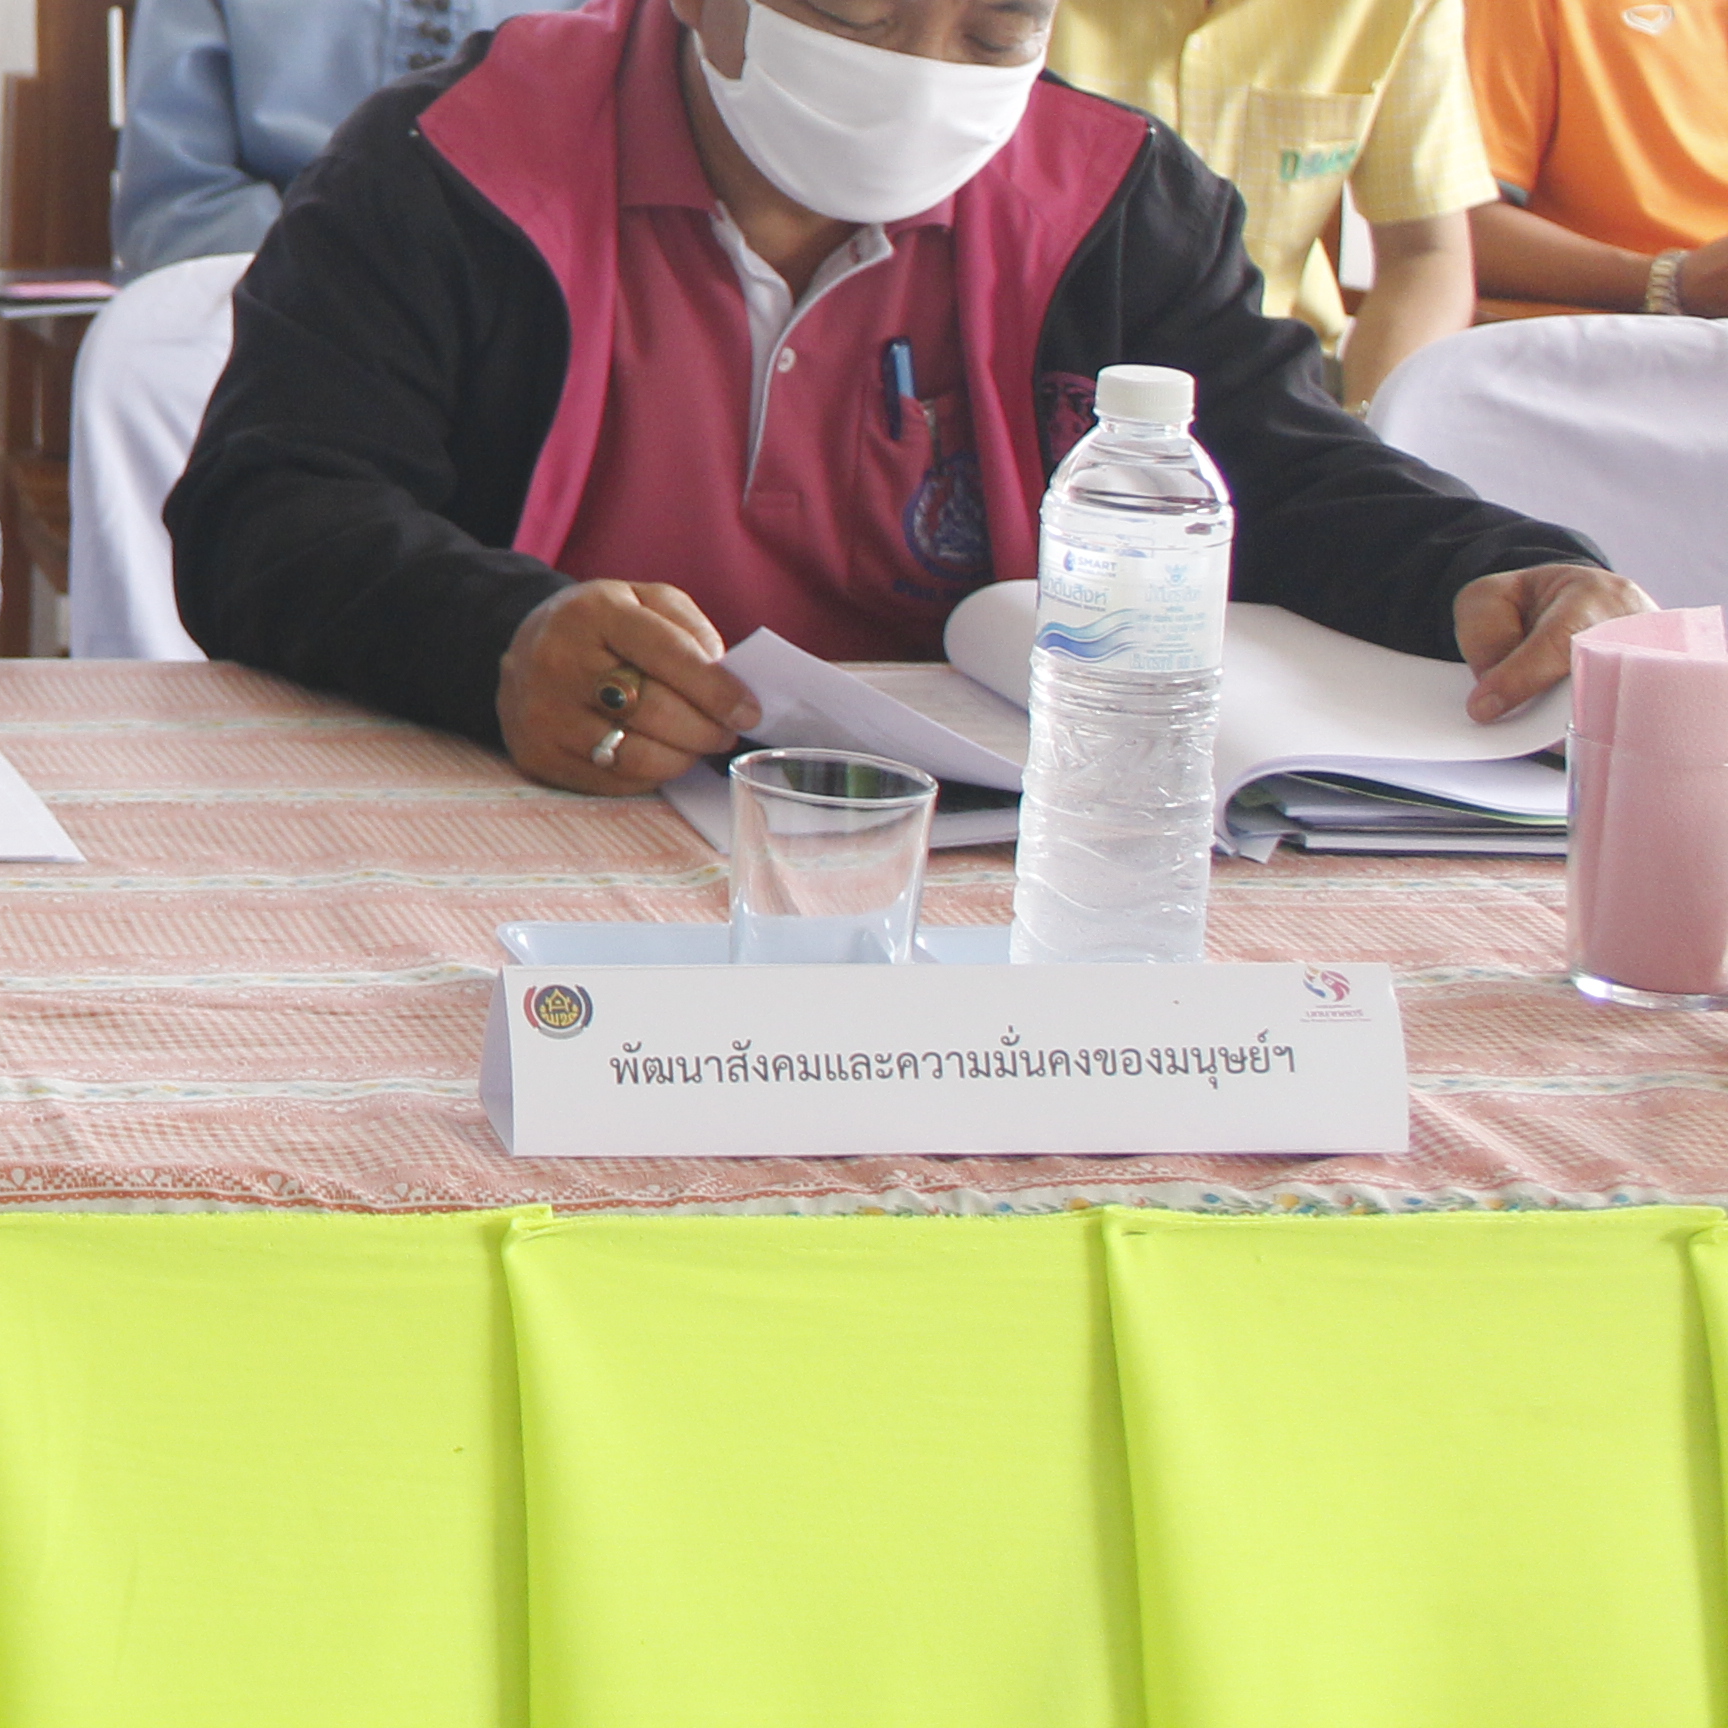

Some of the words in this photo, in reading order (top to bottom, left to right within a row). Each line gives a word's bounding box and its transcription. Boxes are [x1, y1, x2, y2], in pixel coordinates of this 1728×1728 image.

[1077, 556, 1118, 571] SMART
[610, 1026, 1295, 1089] พัฒนาสังคมและความมั่นคงของมนุษย์ฯ
